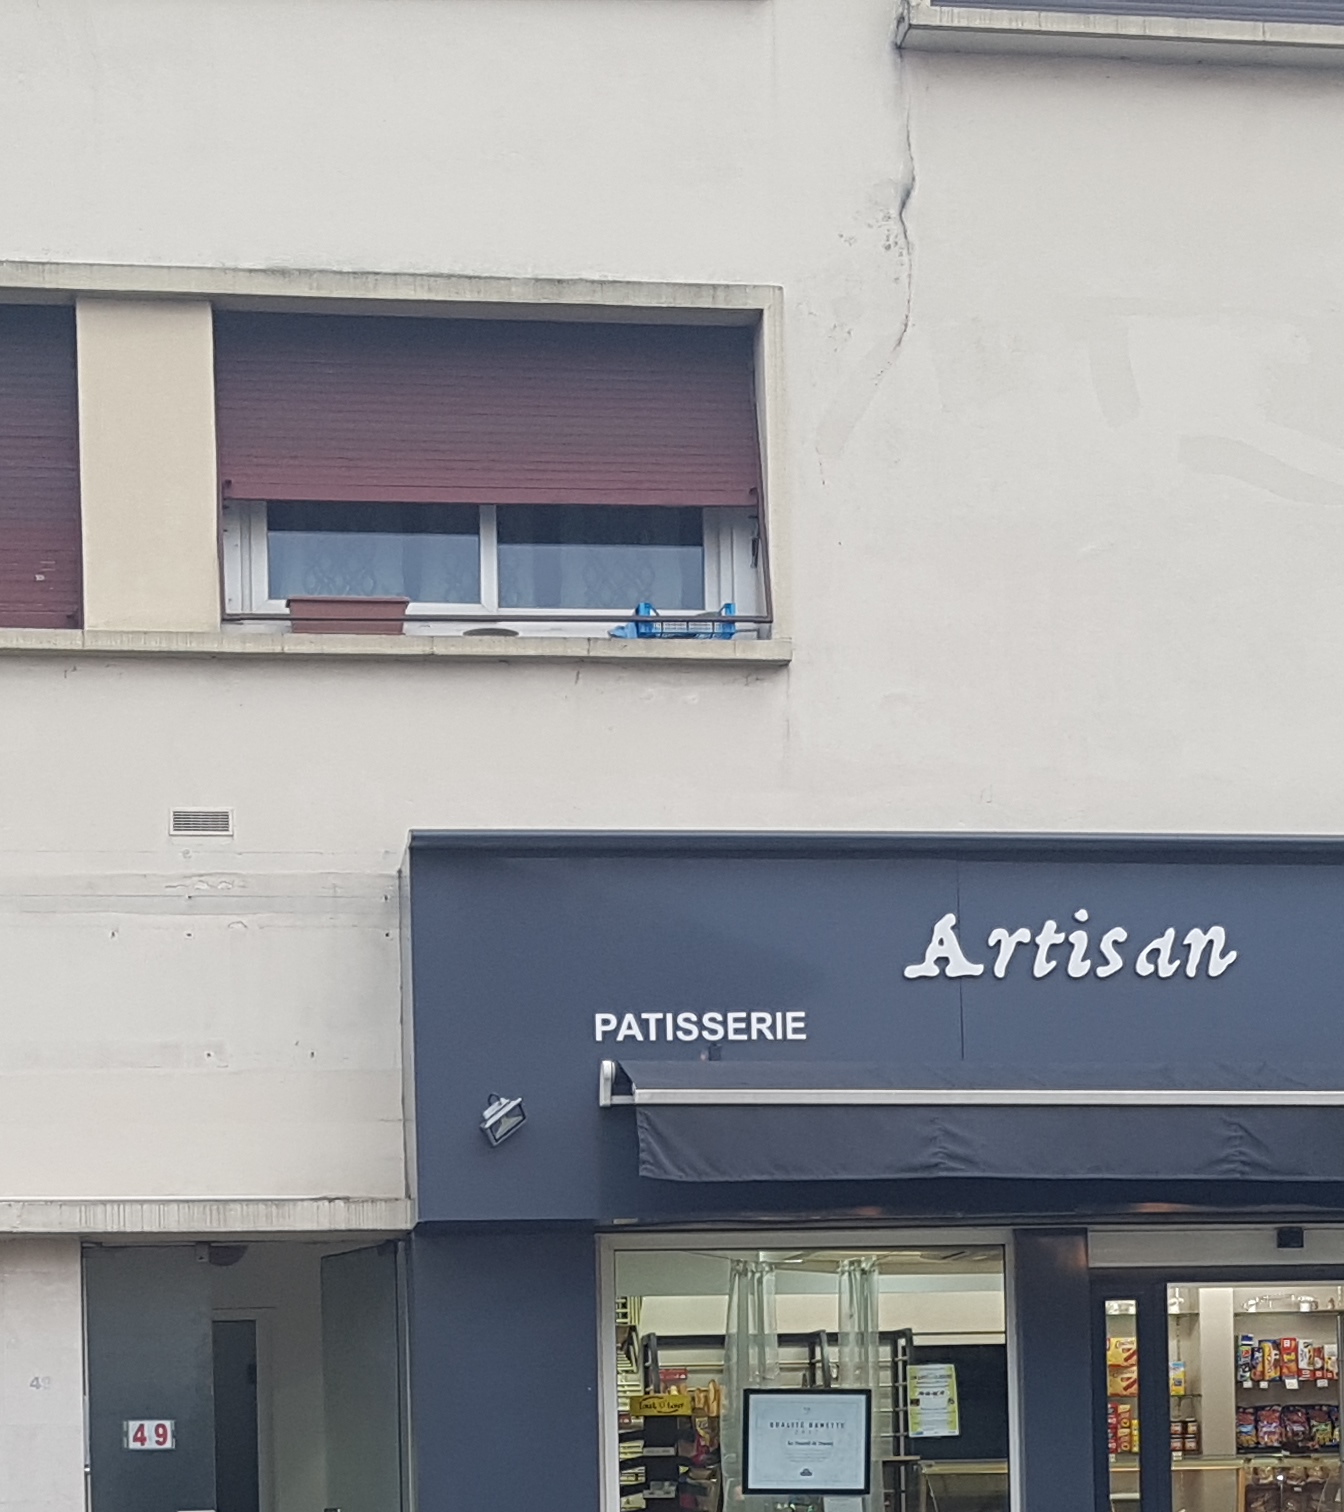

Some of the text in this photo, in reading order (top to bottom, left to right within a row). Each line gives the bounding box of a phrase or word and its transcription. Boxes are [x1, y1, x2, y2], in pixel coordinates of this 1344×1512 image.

[904, 908, 1238, 979] Artisan
[594, 1012, 808, 1043] PATISSERIE
[133, 1423, 168, 1446] 49
